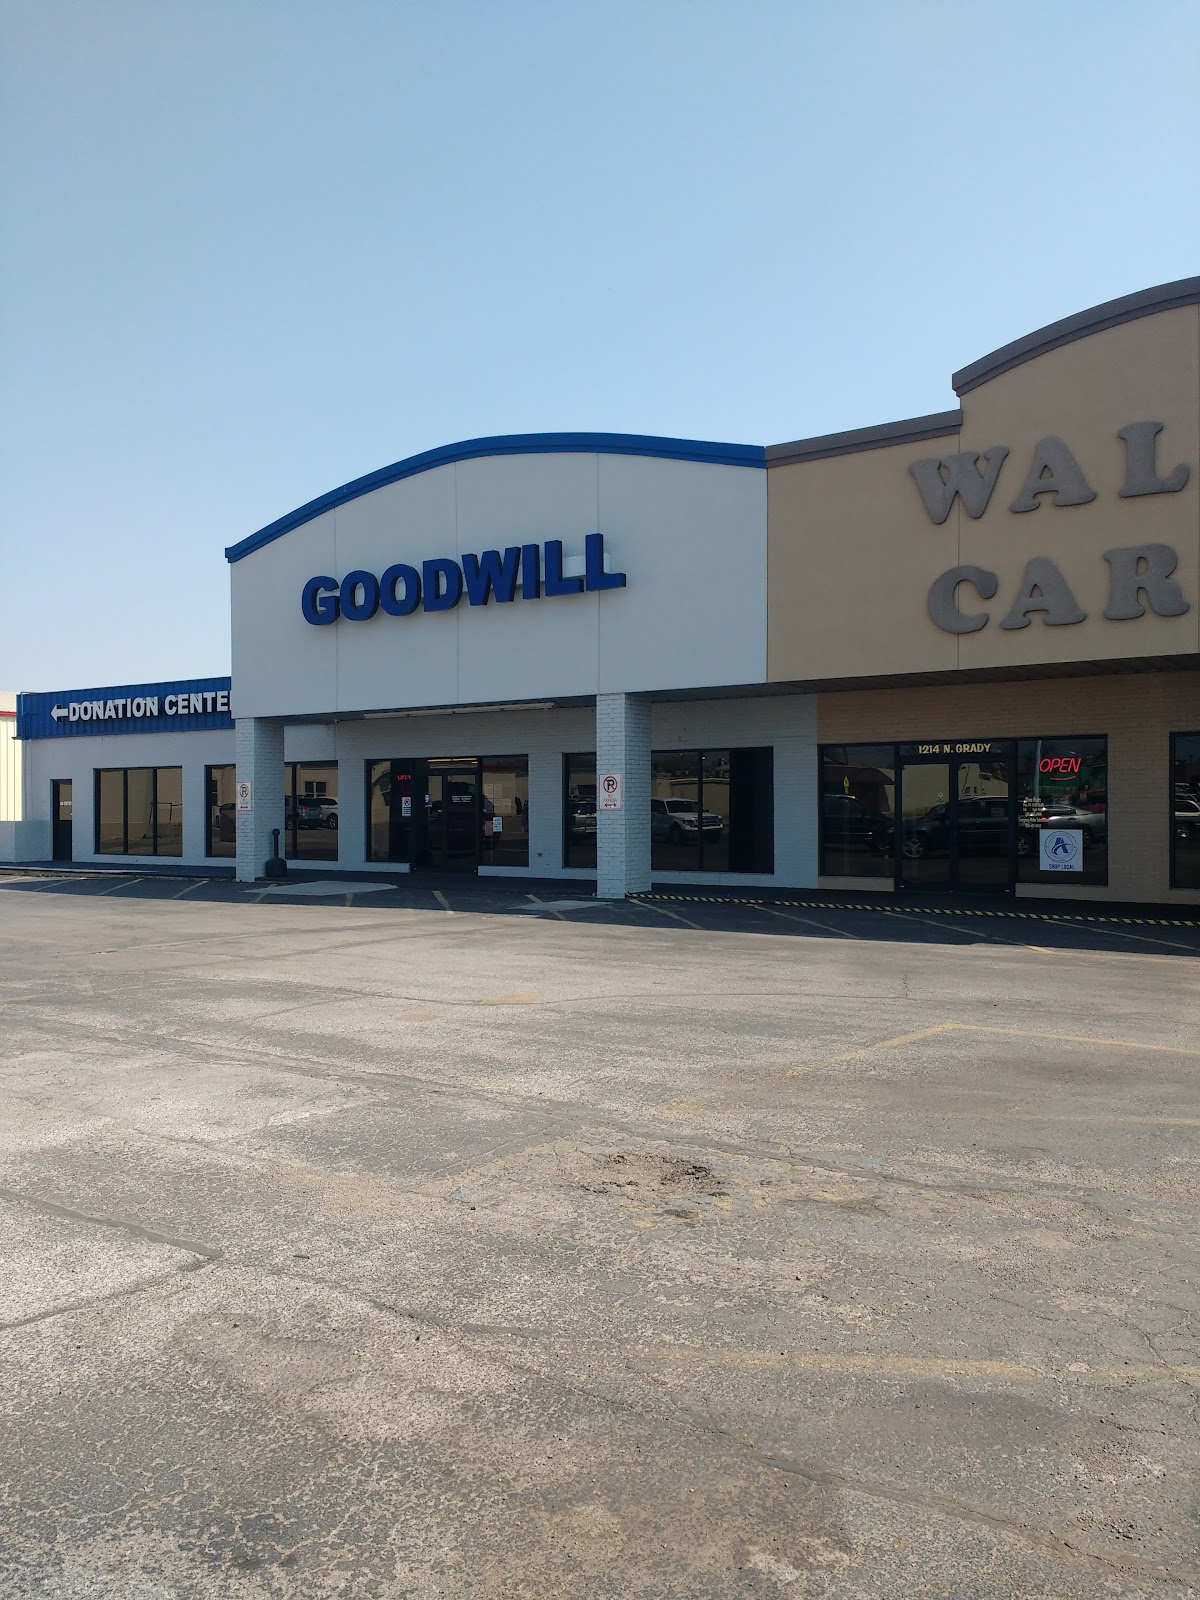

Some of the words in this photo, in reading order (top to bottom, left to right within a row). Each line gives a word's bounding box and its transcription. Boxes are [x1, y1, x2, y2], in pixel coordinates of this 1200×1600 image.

[909, 420, 1190, 525] WAL
[301, 533, 626, 626] GOODWILL
[927, 544, 1191, 634] CAR
[69, 696, 158, 721] DONATION
[165, 691, 231, 715] CENTE
[918, 744, 940, 754] 1214
[943, 744, 954, 754] N.
[956, 743, 992, 753] GRADY
[1039, 758, 1082, 773] OPEN
